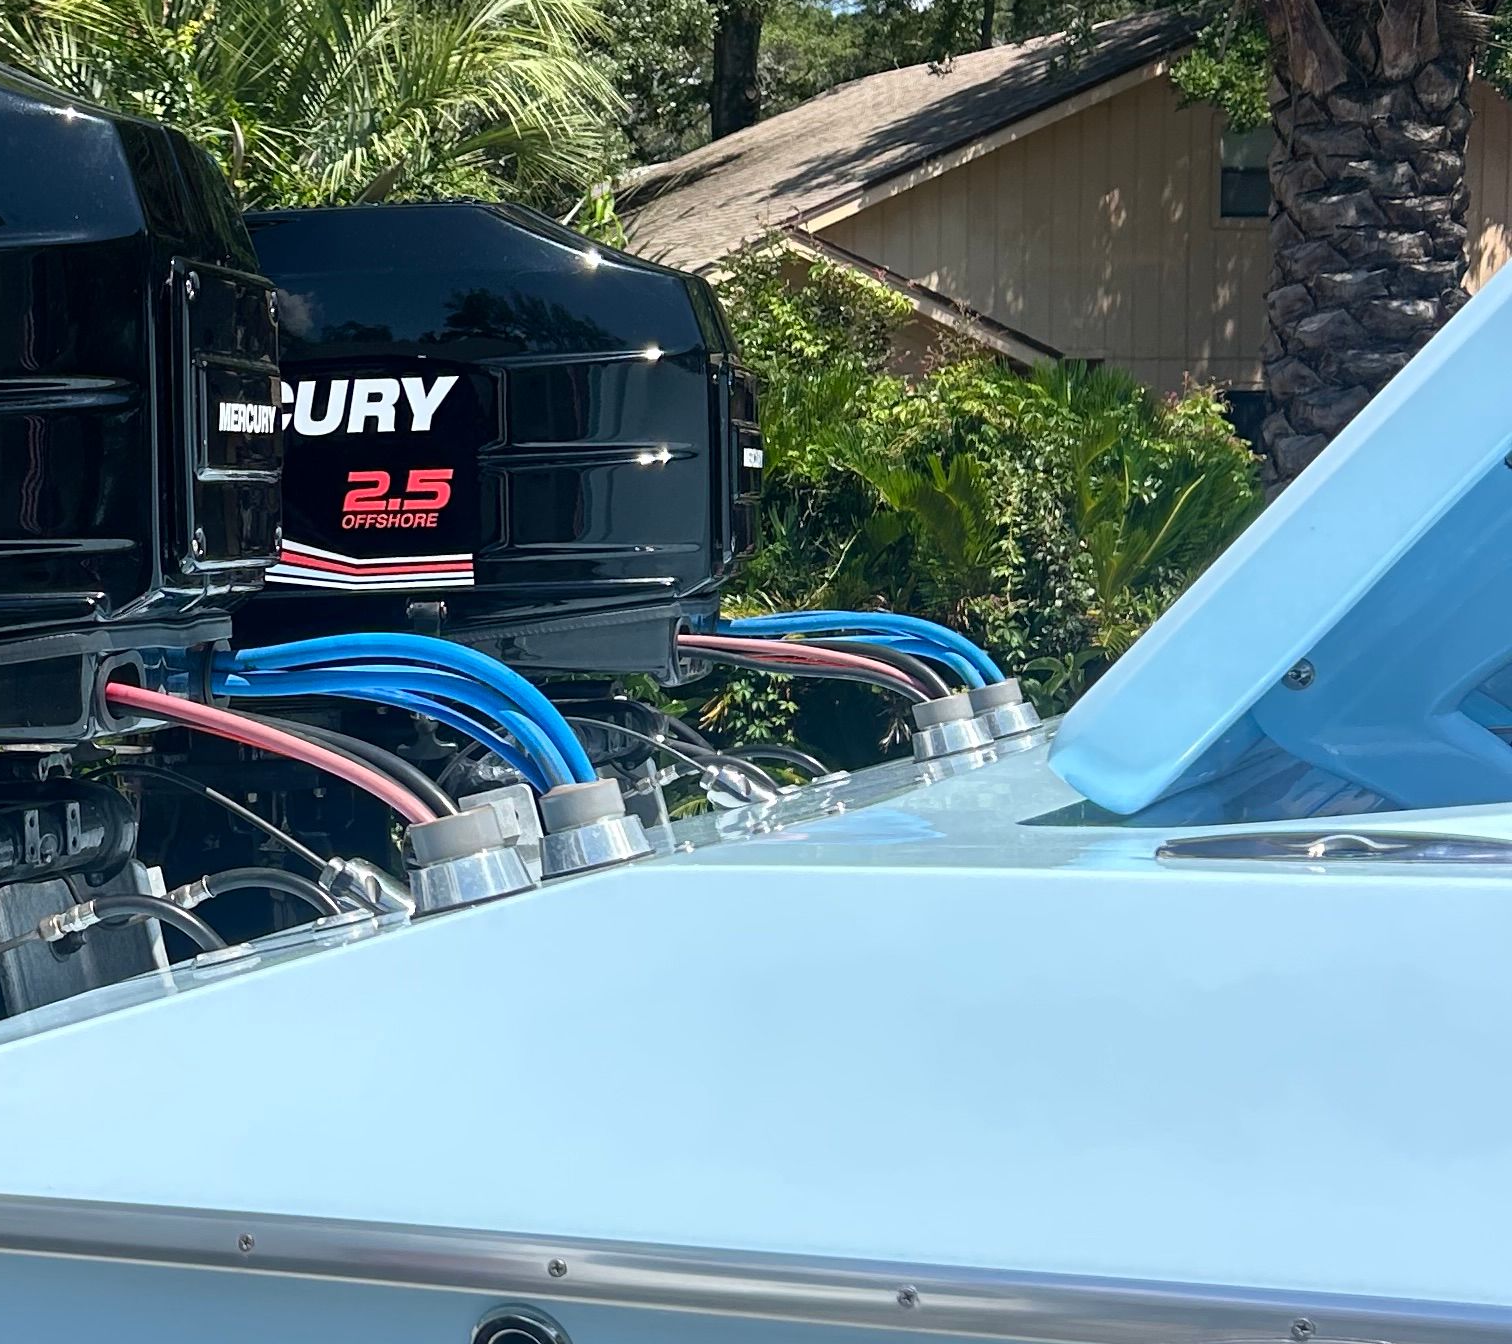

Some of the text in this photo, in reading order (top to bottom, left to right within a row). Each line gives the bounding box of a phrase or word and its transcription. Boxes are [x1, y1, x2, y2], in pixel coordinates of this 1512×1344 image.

[218, 401, 277, 434] MERCURY
[280, 375, 460, 436] URY
[342, 468, 454, 512] 2.5
[341, 512, 439, 529] OFFSHORE
